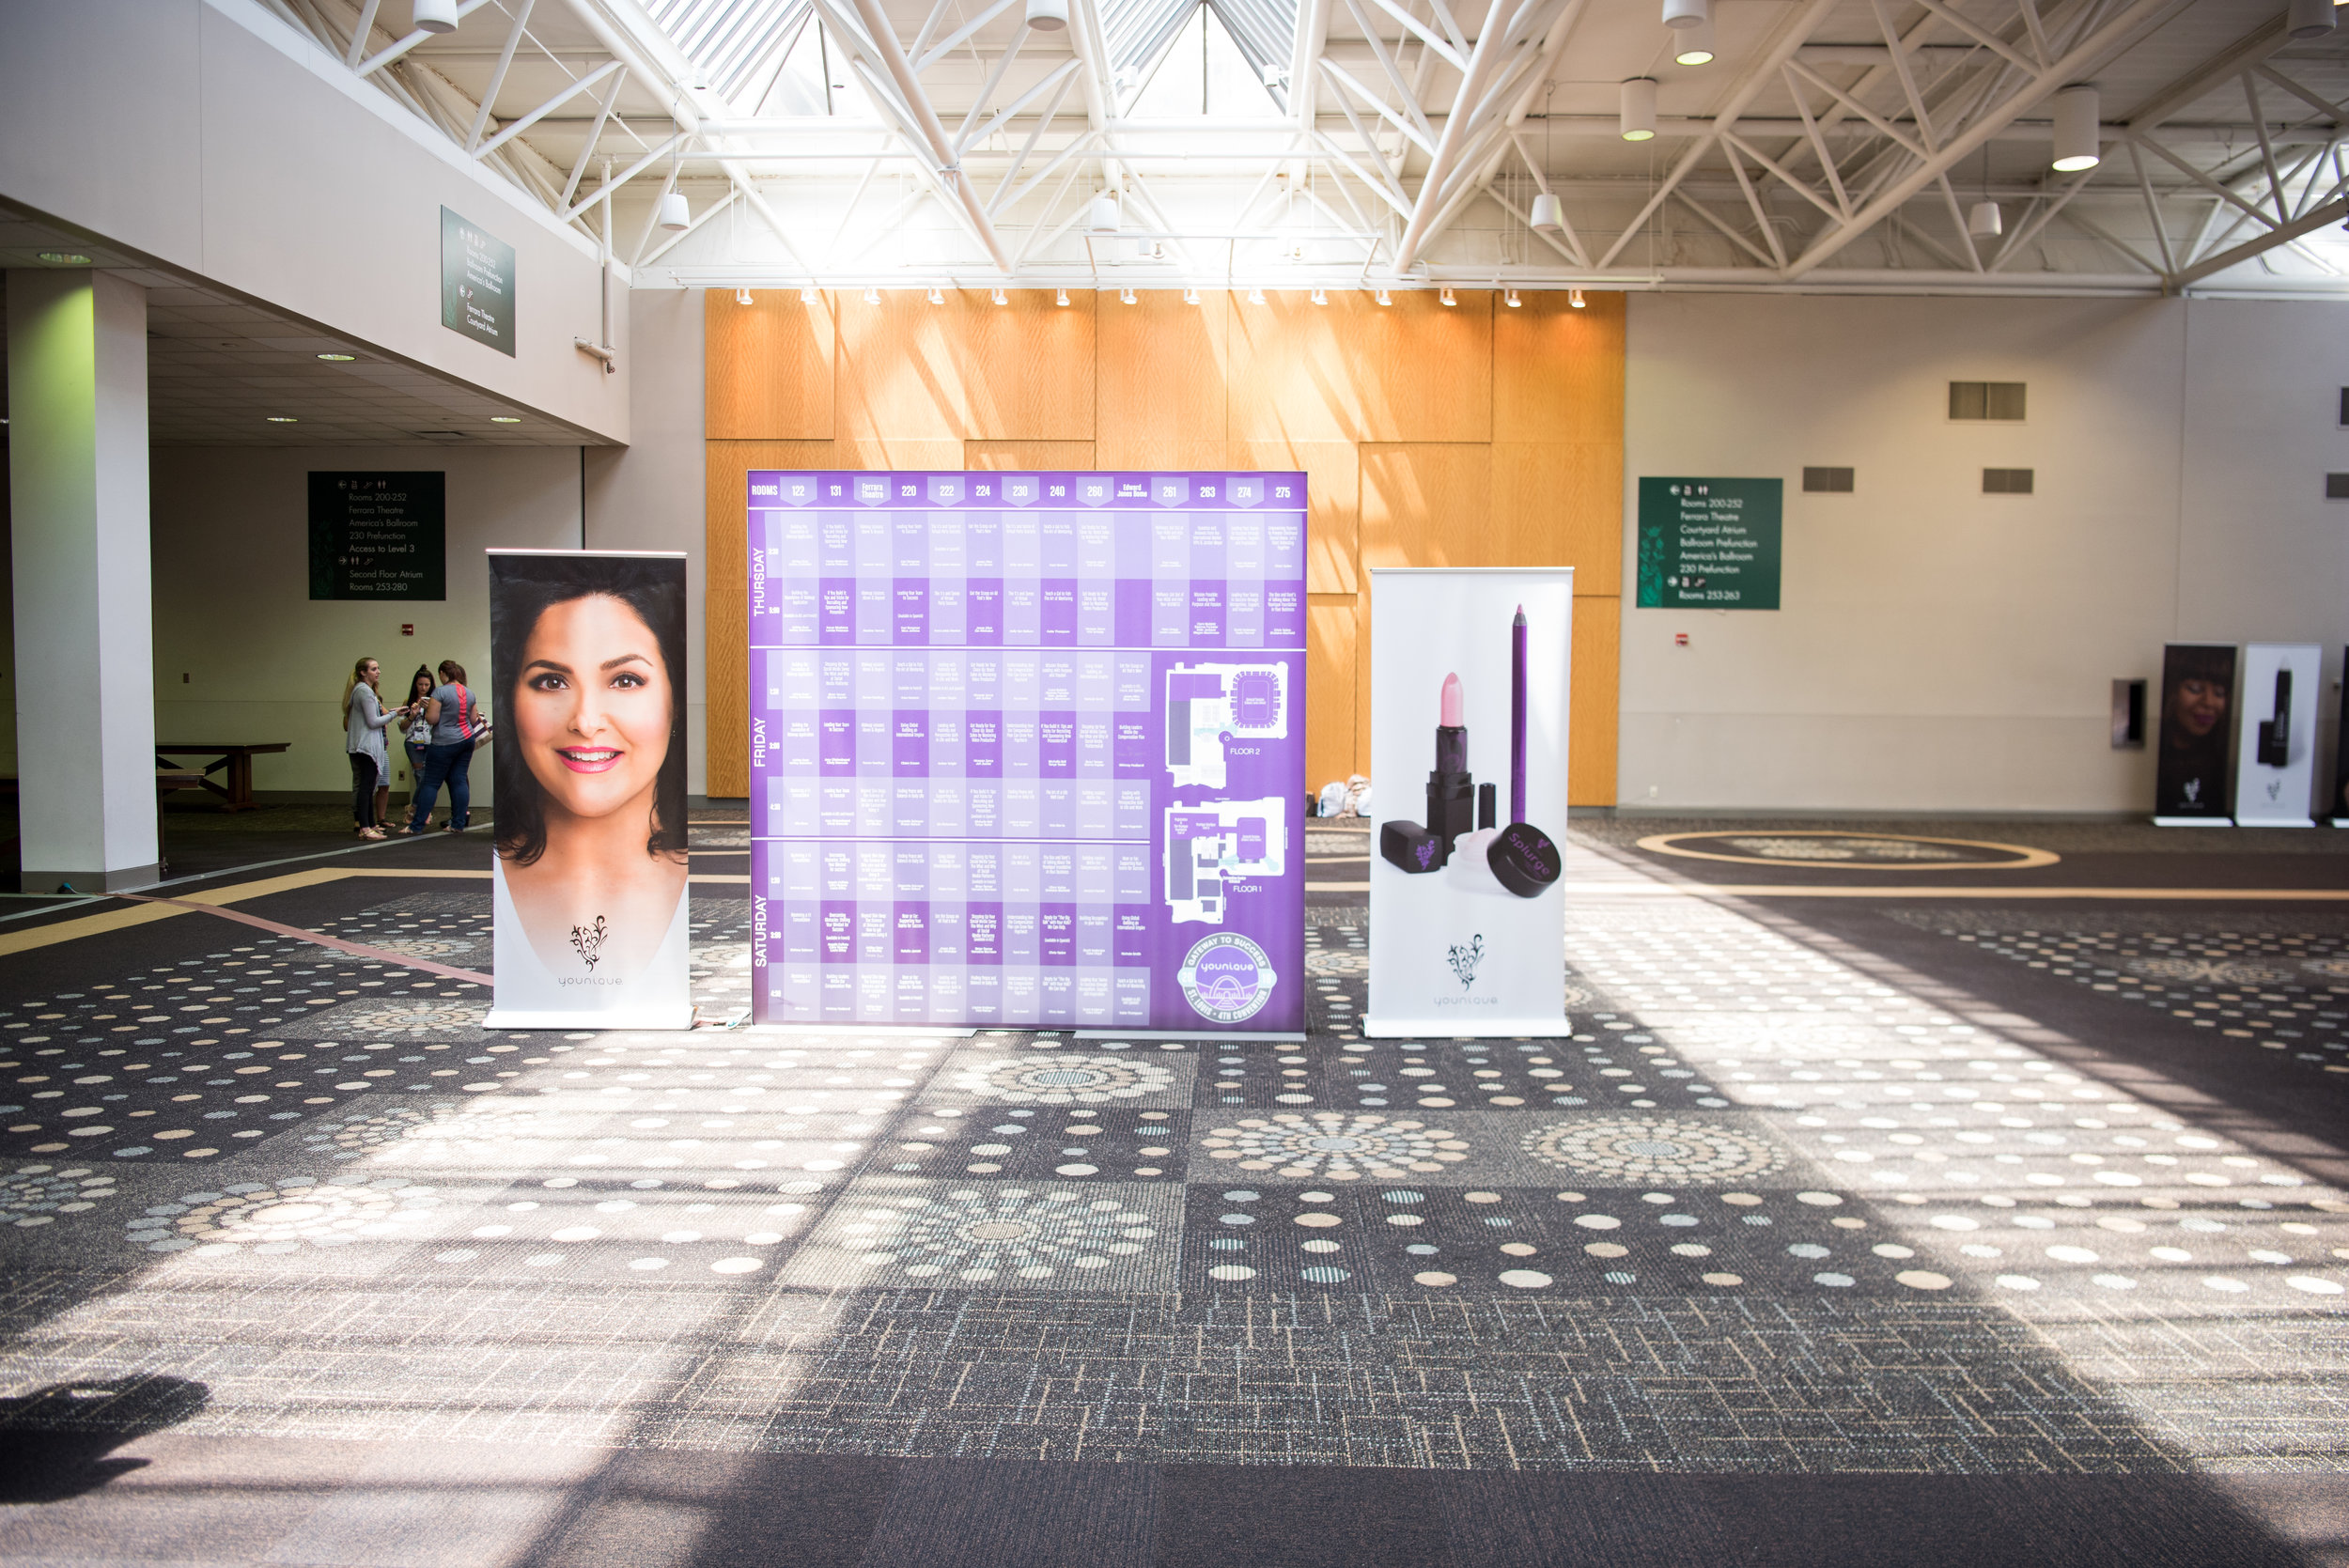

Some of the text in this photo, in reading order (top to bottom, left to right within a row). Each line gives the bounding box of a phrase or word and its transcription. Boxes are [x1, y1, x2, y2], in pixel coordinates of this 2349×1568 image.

[467, 257, 503, 285] Ballroom Prefunction
[467, 271, 501, 295] America's Ballroom
[467, 303, 494, 323] Ferrara Theatre
[467, 315, 498, 336] Courtyard Atrium
[753, 485, 778, 495] ROOMS
[792, 486, 804, 496] 122
[831, 486, 841, 496] 131
[863, 483, 882, 491] Ferrara
[902, 486, 916, 496] 220
[940, 486, 954, 496] 222
[976, 486, 990, 496] 224
[1013, 486, 1028, 496] 230
[1050, 486, 1065, 496] 240
[1163, 487, 1176, 498] 261
[1200, 487, 1216, 498] 263
[1237, 487, 1251, 498] 274
[1276, 487, 1290, 498] 275
[1681, 499, 1706, 507] Rooms
[1681, 512, 1738, 521] Ferrara Theatre
[1680, 525, 1747, 536] Courtyard Atrium
[1680, 538, 1714, 547] Ballroom
[1680, 551, 1753, 561] America's Ballroom
[1679, 565, 1739, 574] 230 Prefunction
[754, 548, 764, 616] THURSDAY
[1679, 591, 1703, 599] Rooms
[754, 718, 766, 768] FRIDAY
[1508, 832, 1550, 875] Splurge
[755, 894, 767, 968] SATURDAY
[1188, 939, 1218, 966] GATEWAY
[1234, 938, 1266, 967] SUCCESS
[1194, 997, 1212, 1016] LOUIS
[1233, 990, 1268, 1019] CONVENTION
